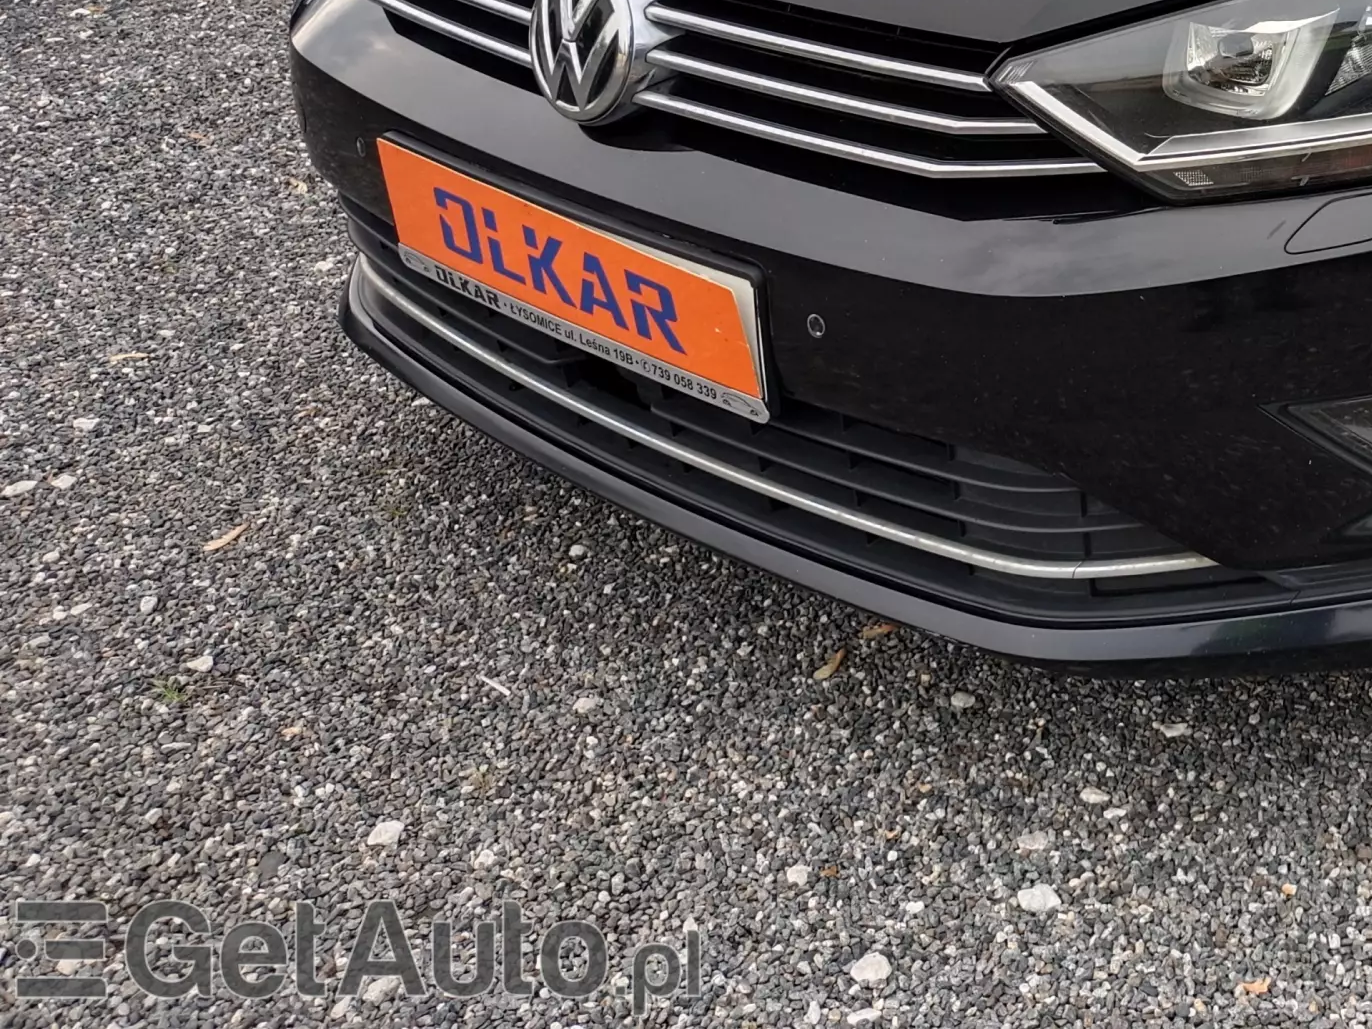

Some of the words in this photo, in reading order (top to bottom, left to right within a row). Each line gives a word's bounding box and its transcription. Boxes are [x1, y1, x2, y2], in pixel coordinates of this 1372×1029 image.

[510, 302, 562, 335] ŁYSOMICE
[564, 329, 577, 342] ul.
[579, 333, 611, 356] Leśna
[613, 348, 634, 365] 19B
[651, 363, 671, 382] 739
[673, 373, 694, 391] 058
[696, 382, 717, 400] 339
